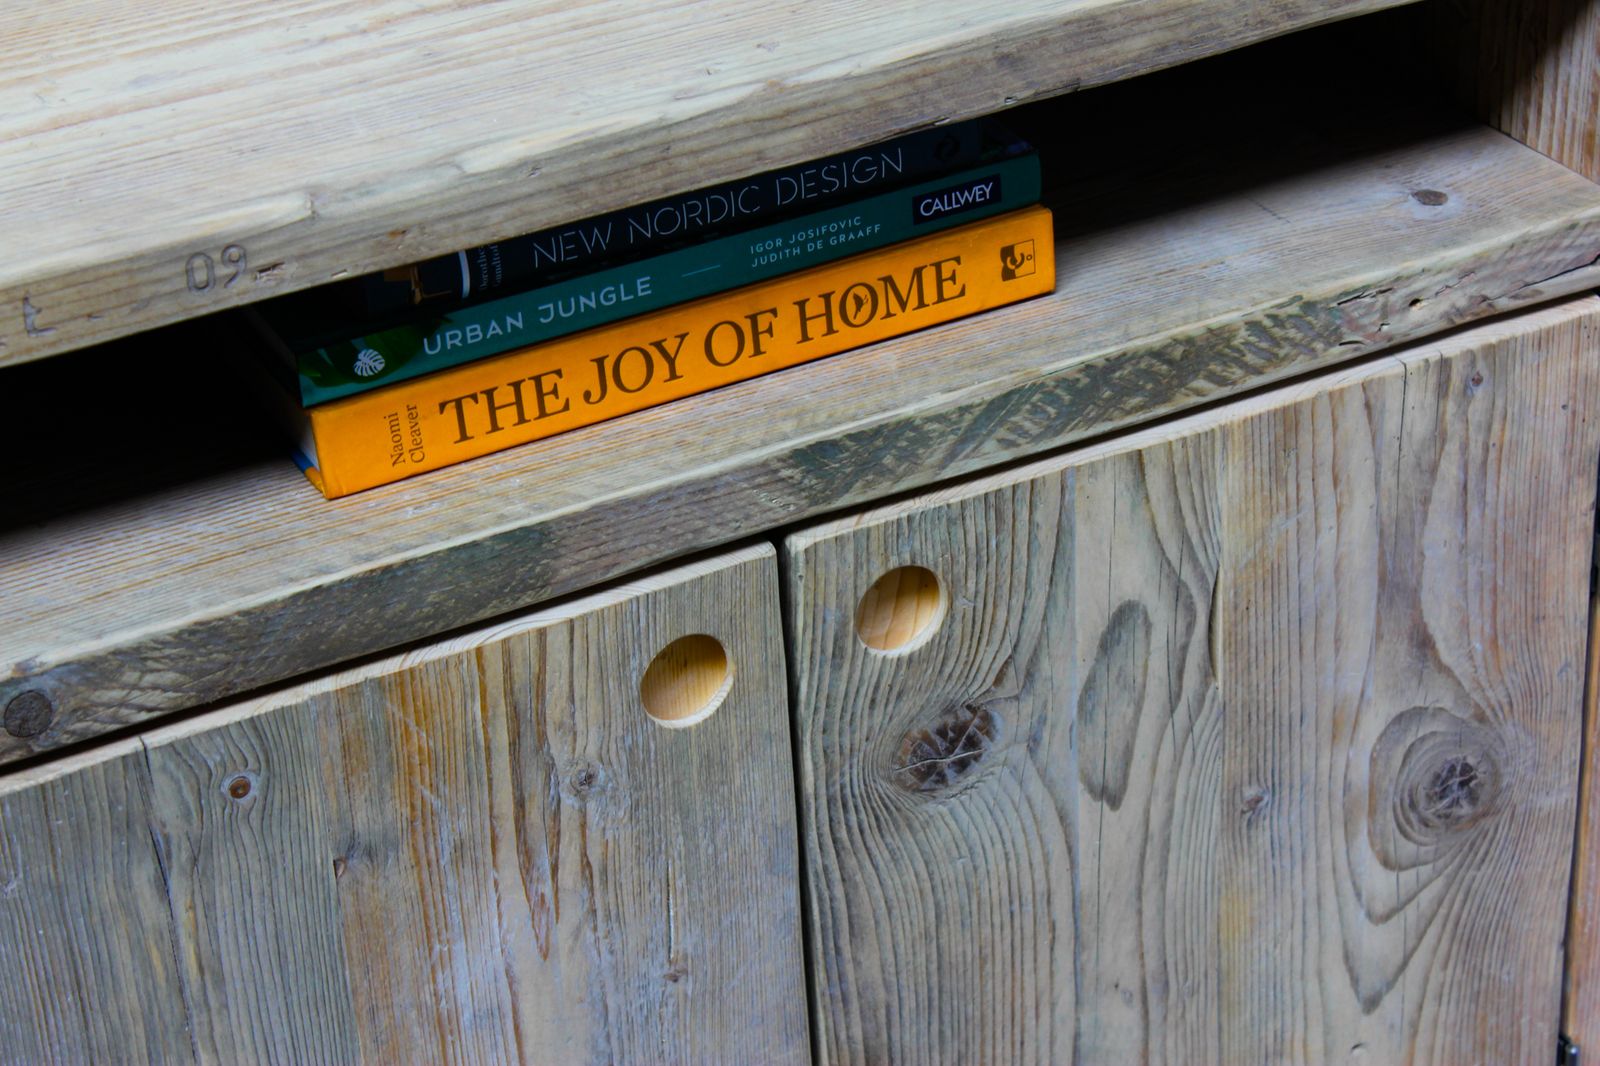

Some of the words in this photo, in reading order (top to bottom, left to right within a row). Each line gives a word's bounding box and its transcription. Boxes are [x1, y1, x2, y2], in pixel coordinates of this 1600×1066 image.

[532, 221, 613, 269] NEW
[628, 185, 761, 245] NORDIC
[775, 147, 903, 207] DESIGN
[919, 181, 994, 217] CALLWEY
[750, 238, 783, 255] IGOR
[788, 216, 863, 245] JOSIFOVIC
[751, 245, 801, 268] JUDITH
[807, 239, 824, 253] DE
[829, 223, 882, 246] GRAAFF
[185, 244, 248, 293] 09
[423, 311, 524, 356] URBAN
[537, 276, 653, 324] JUNGLE
[438, 368, 571, 445] THE
[582, 331, 690, 406] JOY
[703, 307, 779, 368] OF
[793, 255, 967, 345] HOME
[384, 411, 406, 468] Naomi
[406, 403, 425, 464] Cleaver
